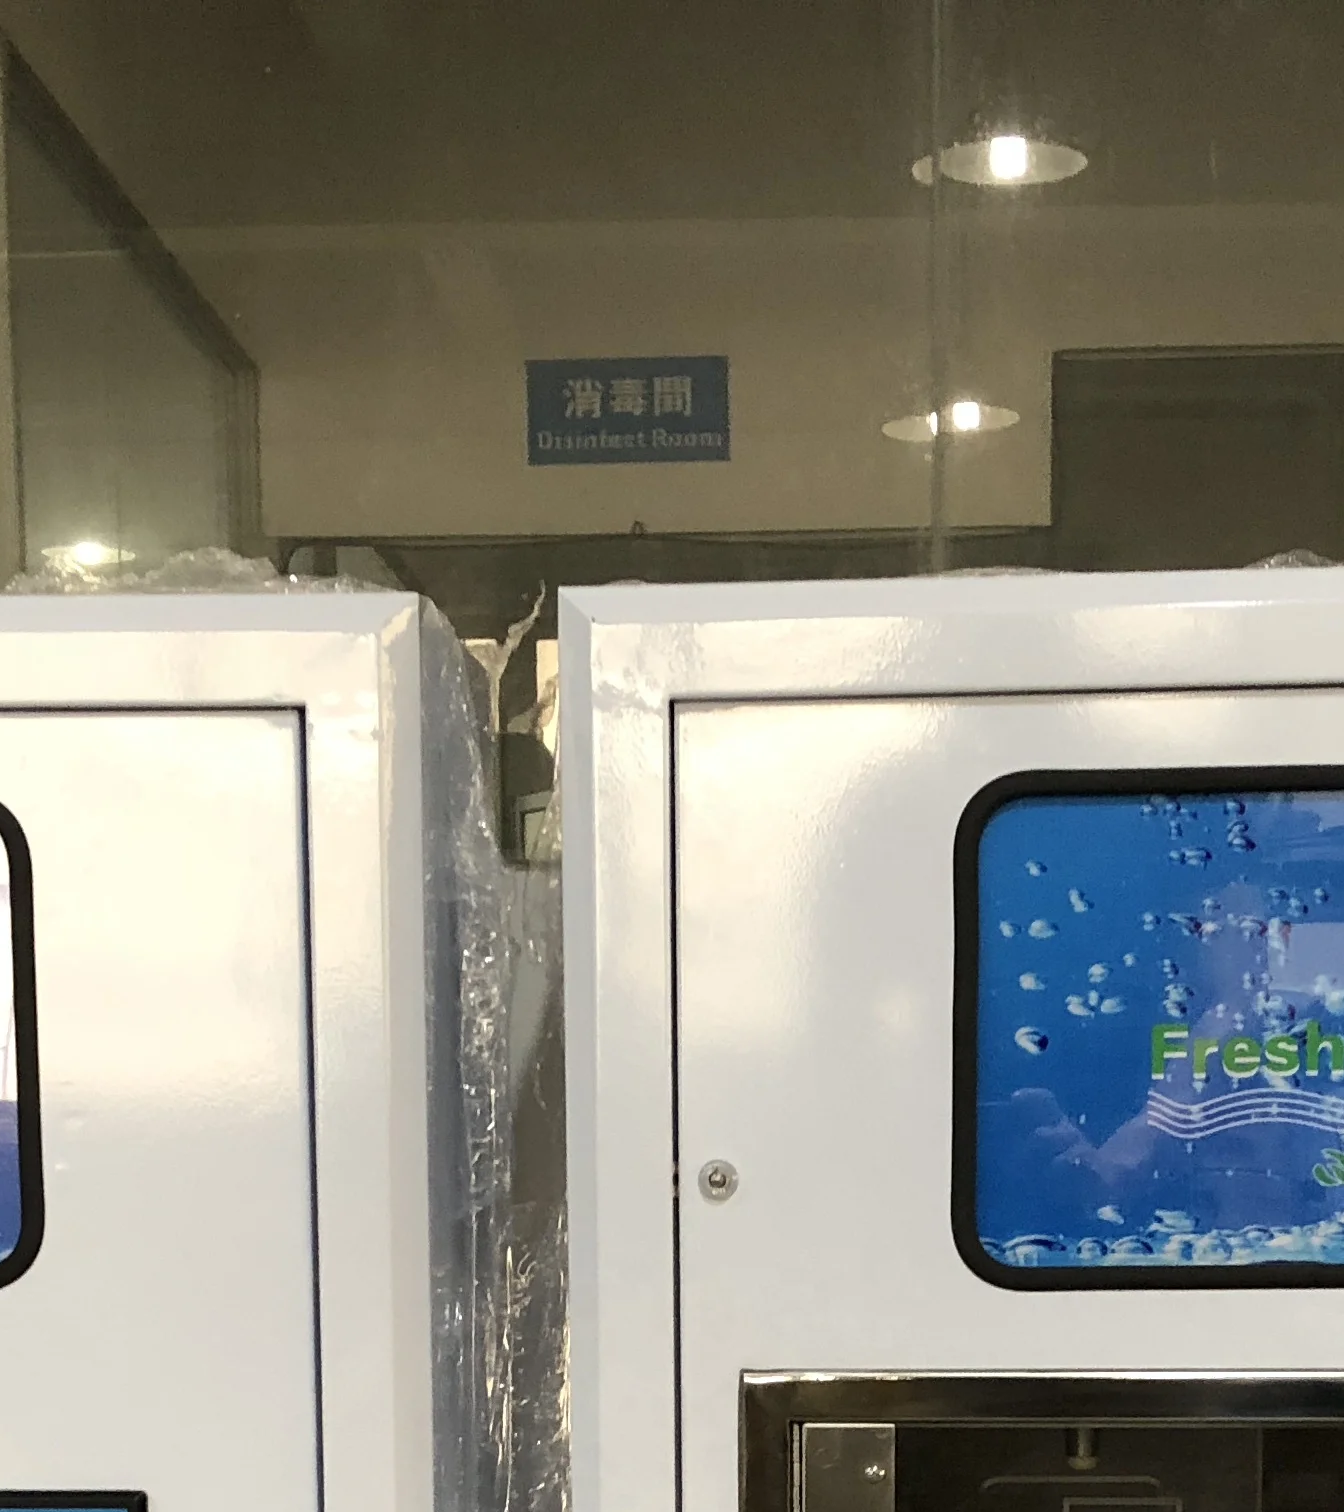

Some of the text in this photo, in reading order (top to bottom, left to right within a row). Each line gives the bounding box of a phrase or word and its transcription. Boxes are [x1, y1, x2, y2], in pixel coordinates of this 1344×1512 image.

[562, 375, 693, 419] 消毒間
[652, 427, 722, 449] Room
